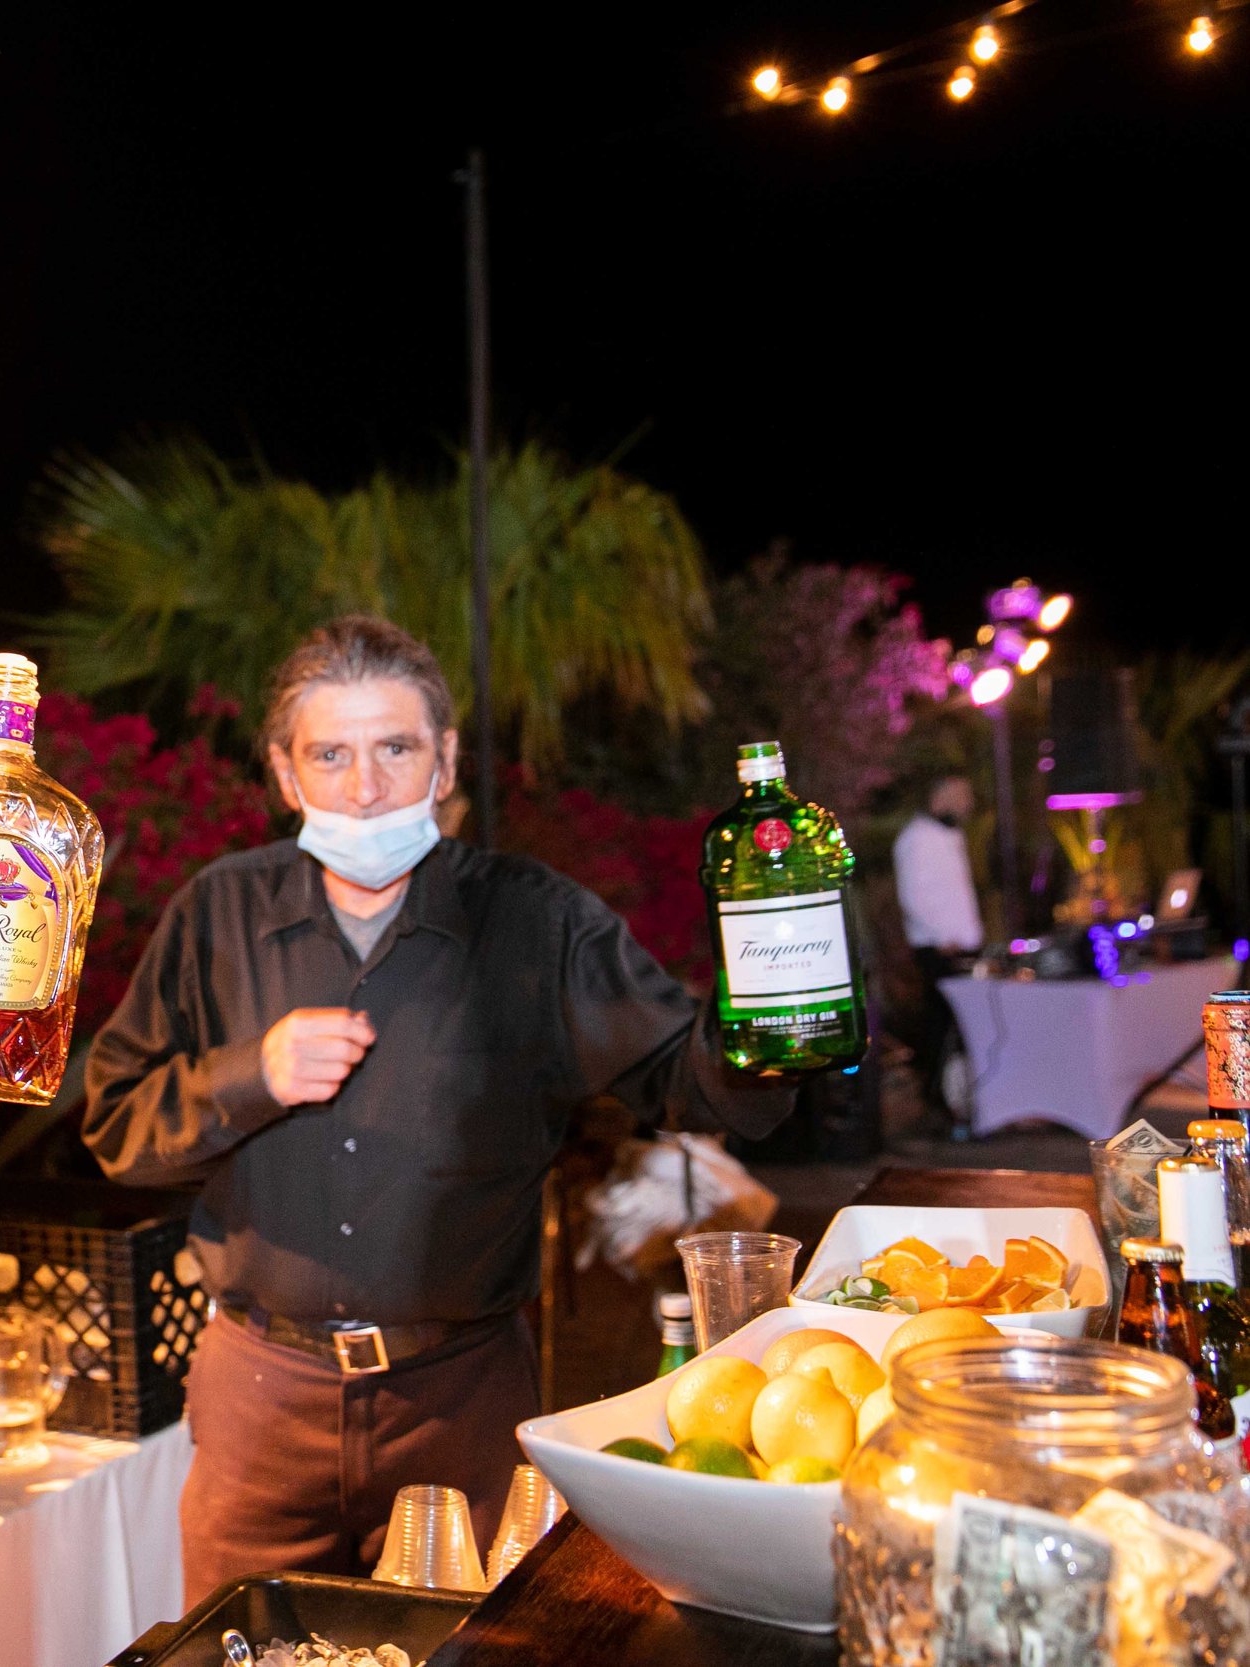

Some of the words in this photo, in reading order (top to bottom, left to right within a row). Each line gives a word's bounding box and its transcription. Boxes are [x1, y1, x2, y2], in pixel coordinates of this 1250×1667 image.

[739, 939, 833, 962] Tanqueray
[11, 954, 38, 968] Whisky
[764, 960, 812, 971] IMPORTED
[752, 1015, 793, 1027] LONDON
[795, 1012, 817, 1024] DRY
[819, 1010, 837, 1021] GIN
